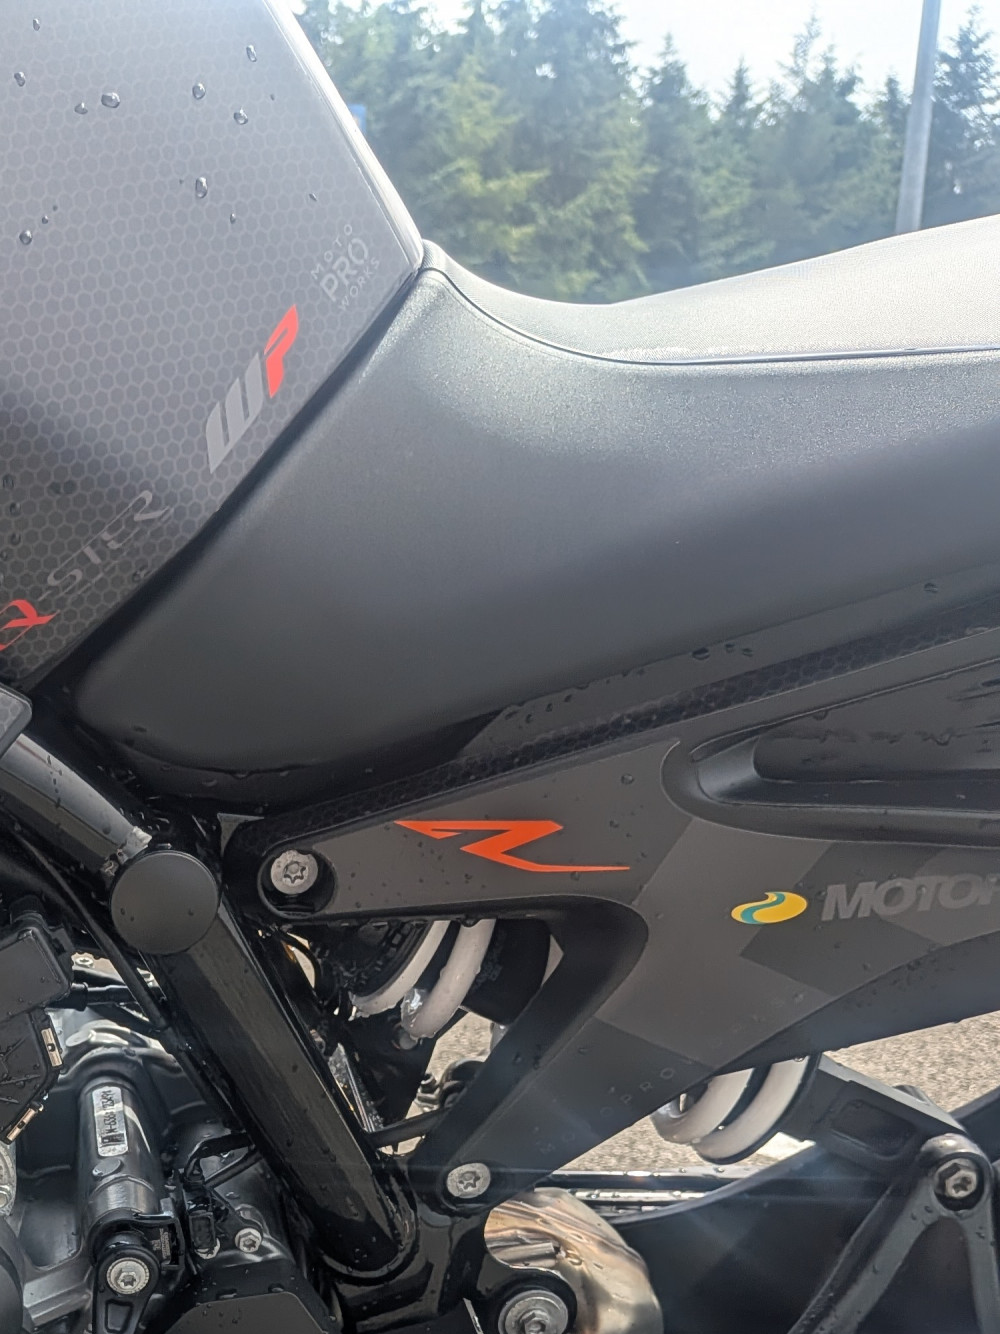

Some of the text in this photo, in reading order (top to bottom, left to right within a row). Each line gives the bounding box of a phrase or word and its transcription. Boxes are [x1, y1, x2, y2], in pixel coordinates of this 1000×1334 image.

[310, 223, 353, 280] MOTO
[320, 237, 369, 302] PRO
[338, 256, 380, 312] WORKS
[204, 305, 299, 474] WP
